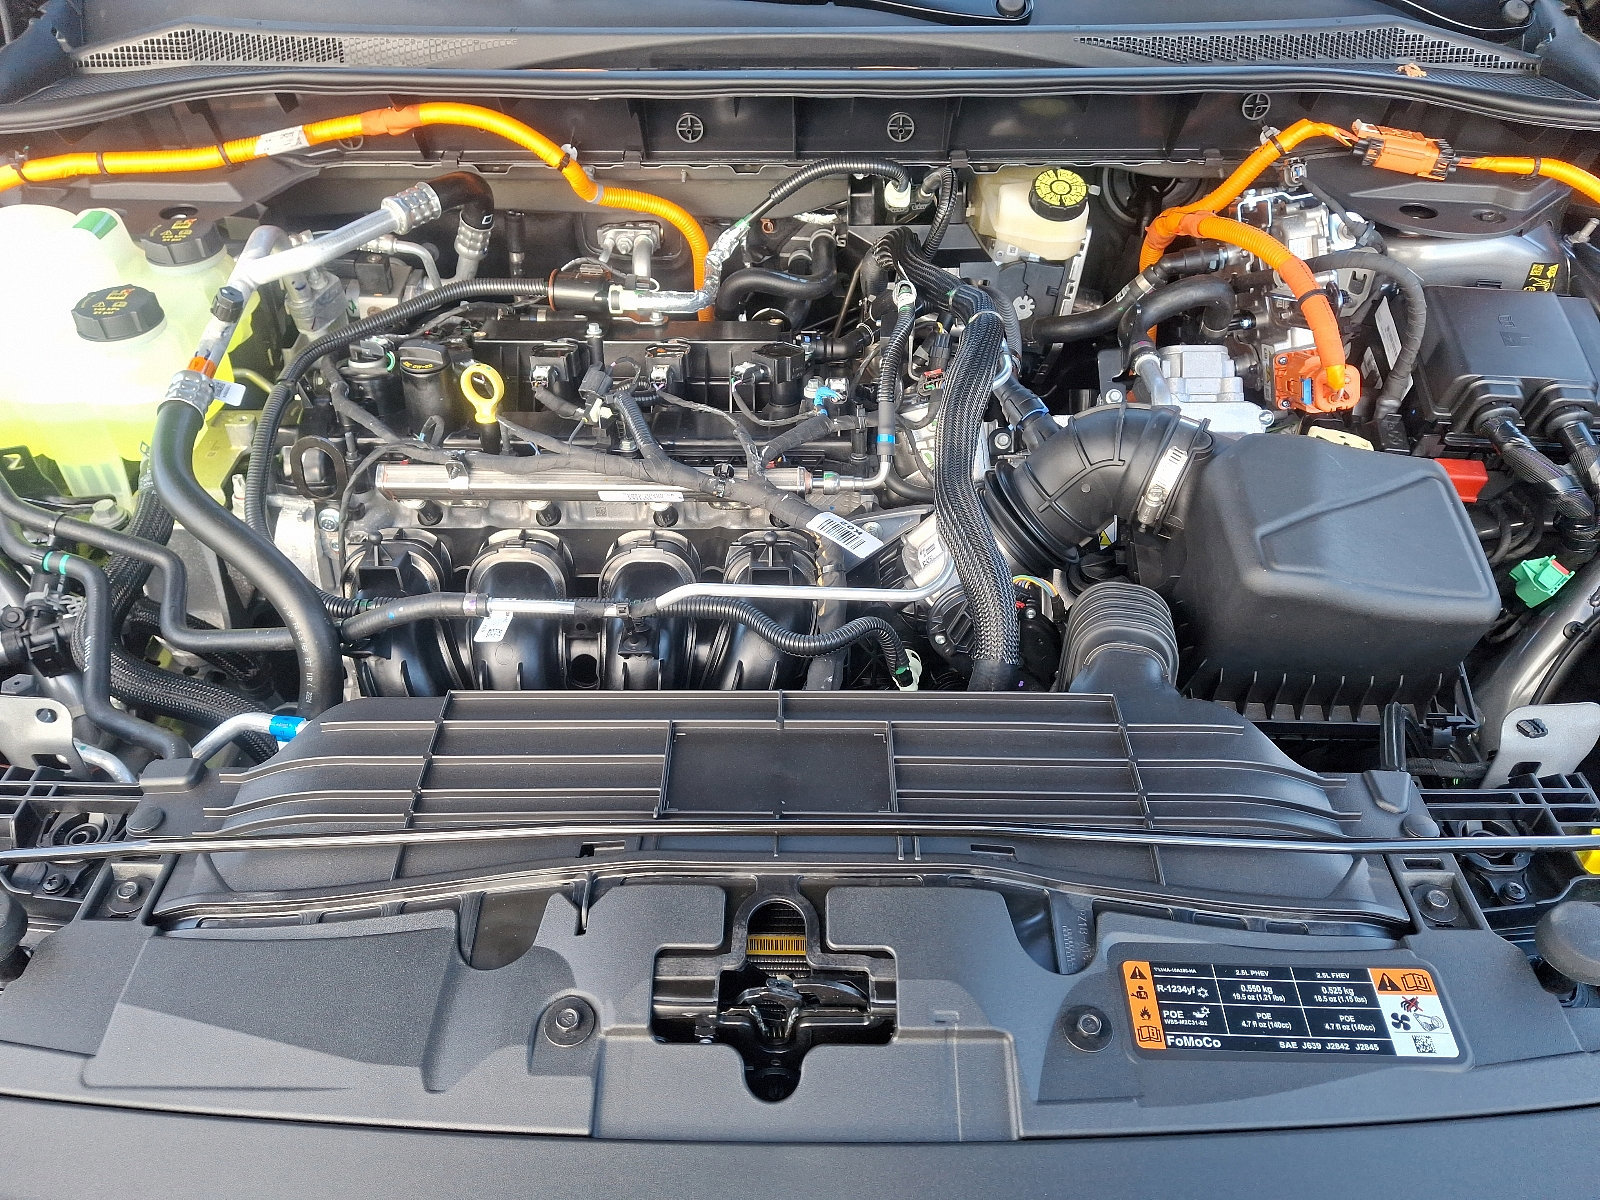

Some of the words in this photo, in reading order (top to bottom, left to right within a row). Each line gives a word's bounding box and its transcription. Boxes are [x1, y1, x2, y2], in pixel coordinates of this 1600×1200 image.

[1156, 984, 1196, 995] R-1234yf
[1240, 984, 1261, 993] 0.550
[1262, 985, 1273, 995] kg
[1321, 986, 1342, 995] 0.525
[1343, 987, 1355, 997] kg
[1162, 1010, 1185, 1019] POE
[1256, 1012, 1273, 1020] POE
[1339, 1014, 1356, 1022] POE
[1241, 1020, 1251, 1028] 4.7
[1267, 1021, 1292, 1030] (140cc)
[1351, 1023, 1376, 1032] (140cc)
[1166, 1035, 1221, 1048] FoMoCo
[1279, 1041, 1298, 1049] SAE
[1302, 1041, 1321, 1050] J639
[1325, 1042, 1350, 1050] J2842
[1355, 1043, 1380, 1051] J2845
